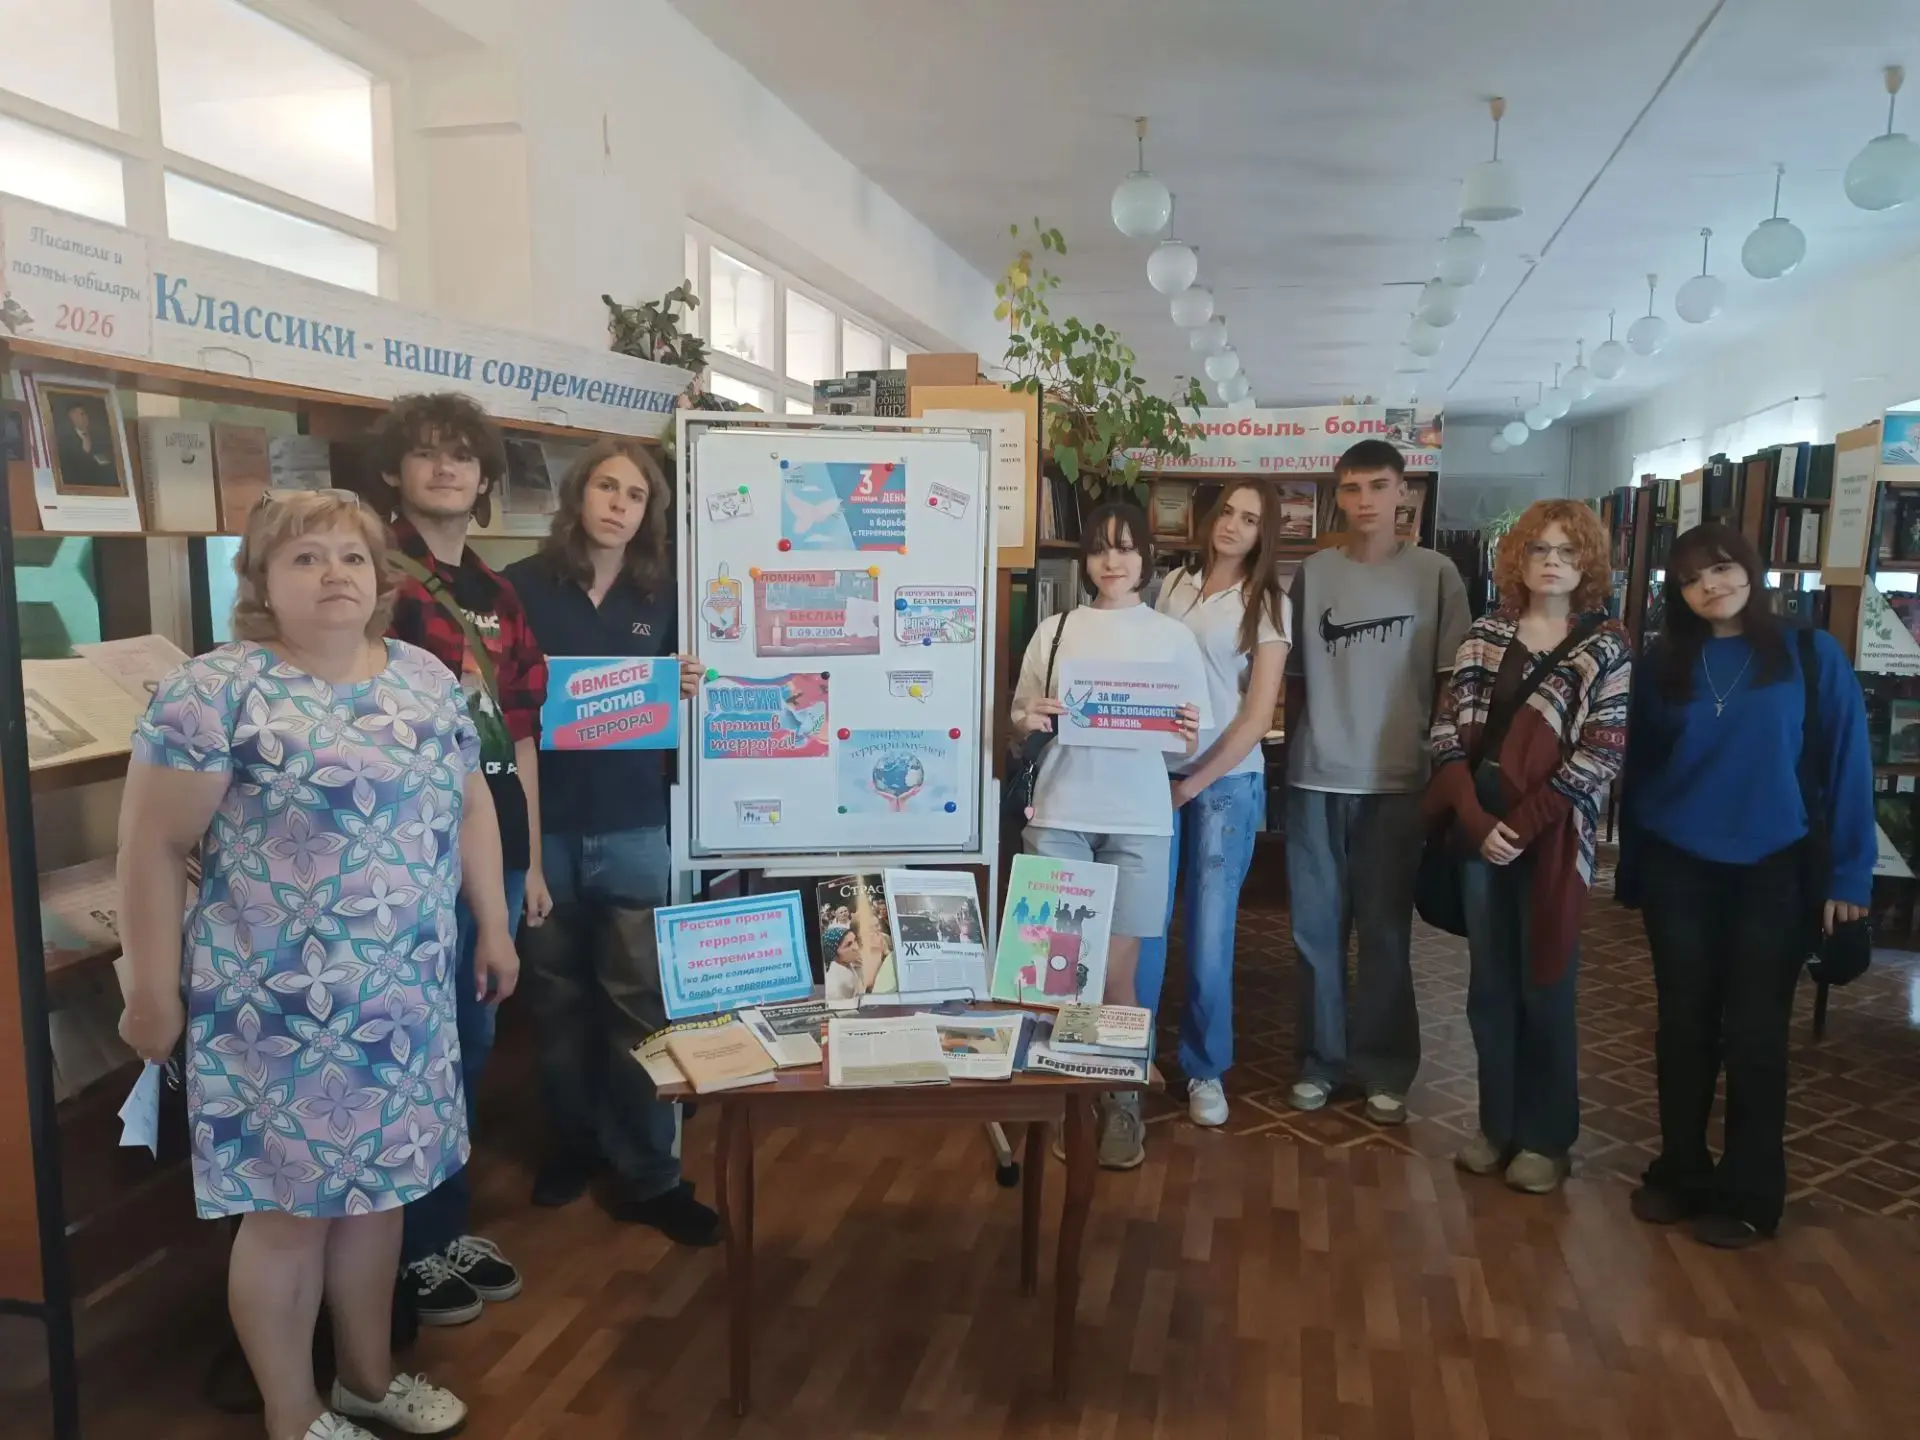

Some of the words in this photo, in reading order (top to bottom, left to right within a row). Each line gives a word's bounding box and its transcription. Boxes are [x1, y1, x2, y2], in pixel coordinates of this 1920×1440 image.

[30, 226, 109, 261] Писатели
[114, 252, 122, 265] и
[12, 259, 140, 302] поэты-юбиляры
[55, 303, 114, 338] 2026
[154, 272, 356, 359] Классики
[384, 338, 474, 380] наши
[482, 359, 678, 414] современники
[859, 469, 873, 494] 3
[761, 573, 816, 583] ПОМНИМ
[789, 611, 844, 622] БЕСЛАН
[570, 663, 650, 697] #ВМЕСТЕ
[576, 690, 645, 720] ПРОТИВ
[708, 688, 780, 713] РОССИЯ
[1097, 692, 1109, 702] ЗА
[1111, 693, 1130, 702] МИР
[1097, 705, 1109, 715] ЗА
[1111, 706, 1177, 718] БЕЗОПАСНОСТЬ
[1097, 717, 1109, 727] ЗА
[1111, 719, 1142, 728] ЖИЗНЬ
[576, 712, 652, 742] ТЕРРОРА!
[710, 714, 781, 738] против
[710, 732, 796, 756] террора!
[486, 761, 501, 775] OF
[1050, 870, 1075, 882] НЕТ
[1027, 880, 1096, 898] ТЕРРОРИЗМУ
[735, 910, 783, 925] против
[700, 932, 755, 949] террора
[760, 930, 768, 940] и
[687, 947, 783, 970] экстремизма
[725, 961, 792, 979] солидарности
[1036, 1054, 1136, 1077] Терроризм
